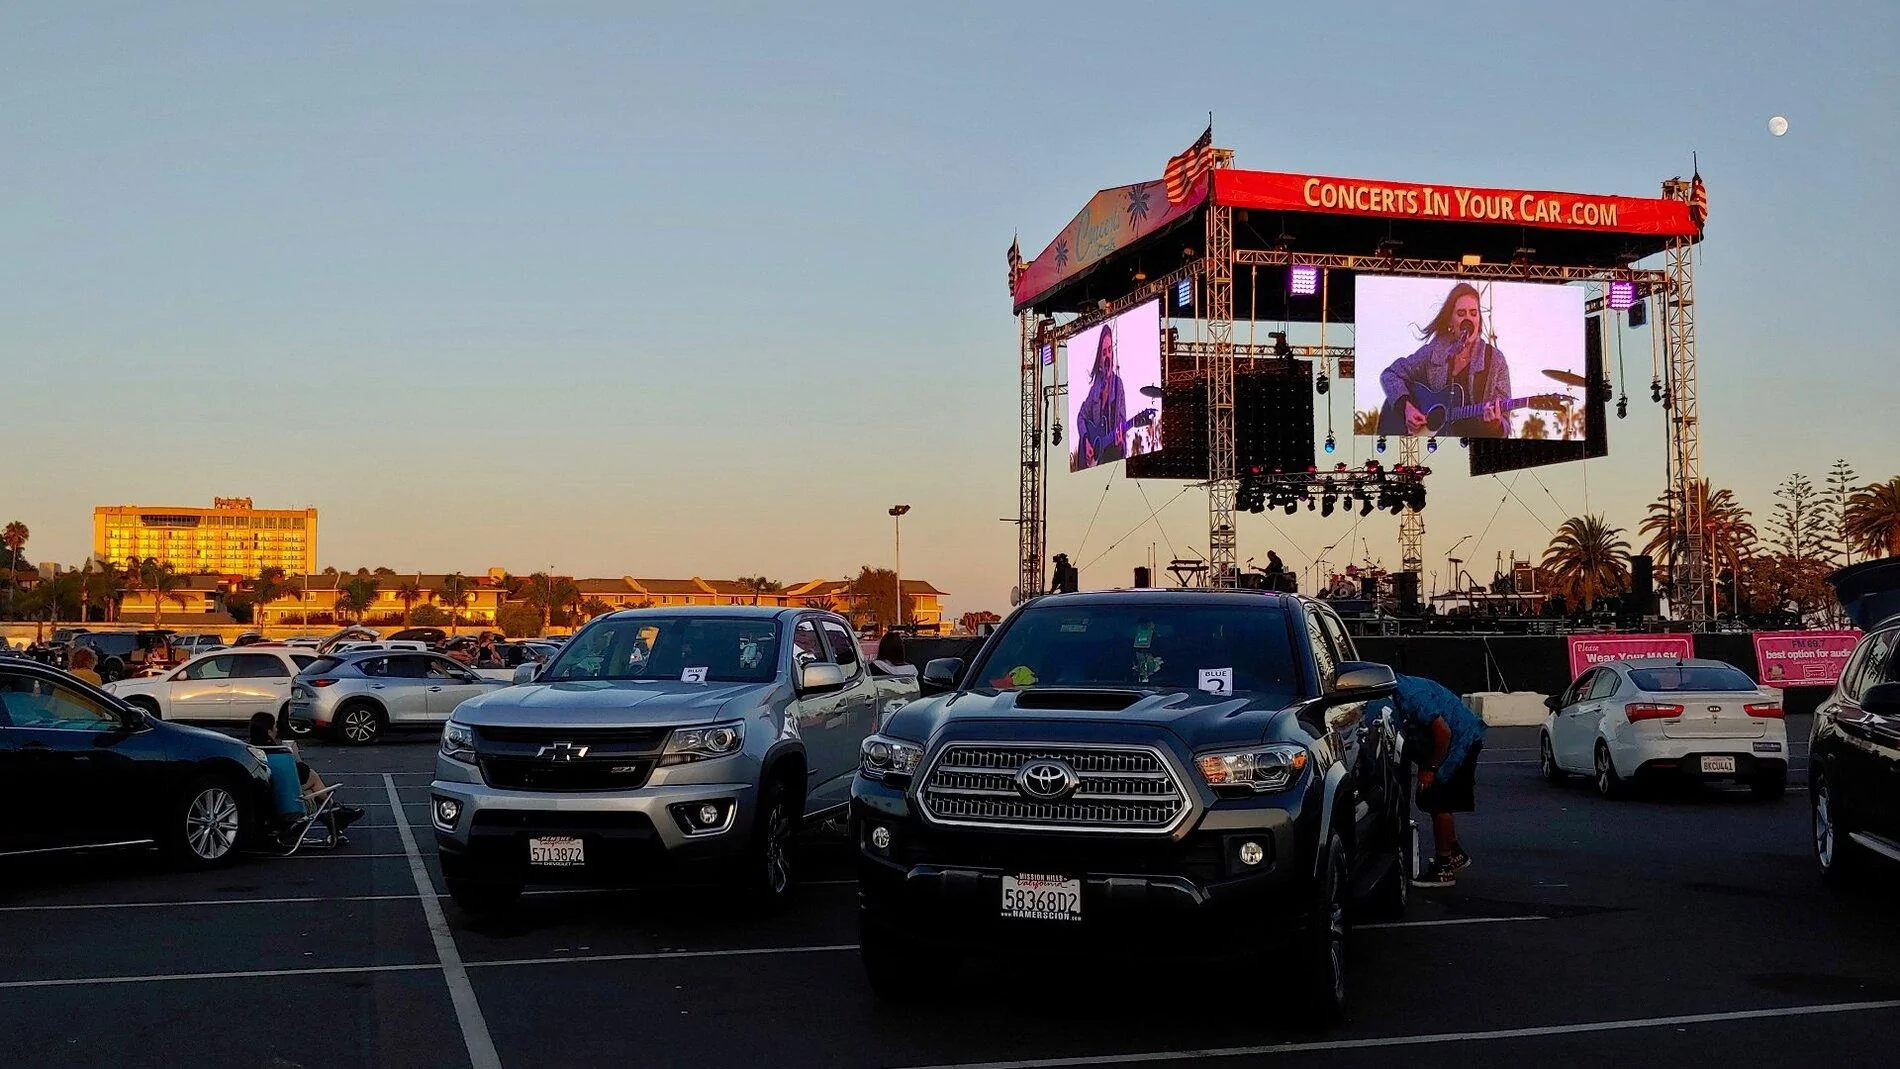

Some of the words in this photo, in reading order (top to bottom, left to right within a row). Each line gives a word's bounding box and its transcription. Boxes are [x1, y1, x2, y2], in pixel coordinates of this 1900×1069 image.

[1303, 178, 1419, 214] CONCERTS
[1422, 187, 1450, 217] IN
[1455, 189, 1516, 220] YOUR
[1586, 653, 1616, 663] Wear
[1618, 652, 1645, 660] Your
[1646, 651, 1678, 659] MASK
[1766, 650, 1786, 659] best
[1787, 650, 1815, 660] option
[1816, 649, 1829, 658] for
[1207, 679, 1224, 693] 2
[1005, 889, 1077, 912] 58368D2
